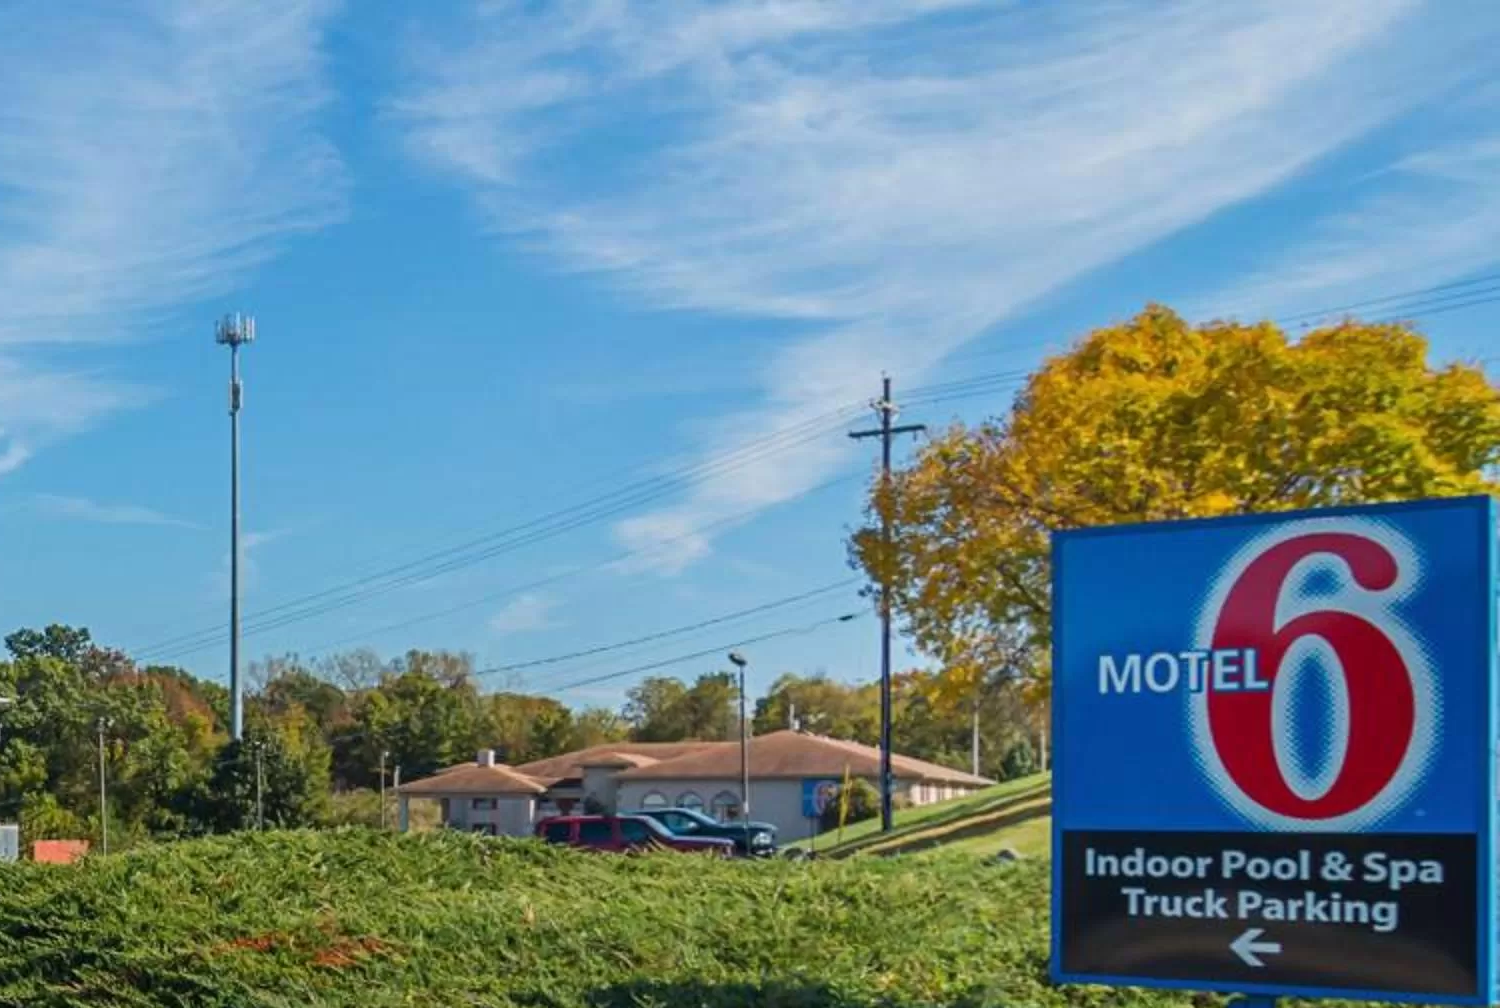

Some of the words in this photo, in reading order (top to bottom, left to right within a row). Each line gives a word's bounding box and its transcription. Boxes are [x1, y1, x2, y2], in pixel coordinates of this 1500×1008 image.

[1099, 648, 1268, 694] MOTEL
[1206, 531, 1415, 821] 6
[1085, 848, 1212, 877] Indoor
[1222, 850, 1311, 880] Pool
[1321, 851, 1354, 882] &
[1362, 852, 1444, 890] Spa
[1121, 887, 1228, 918] Truck
[1237, 890, 1398, 932] Parking
